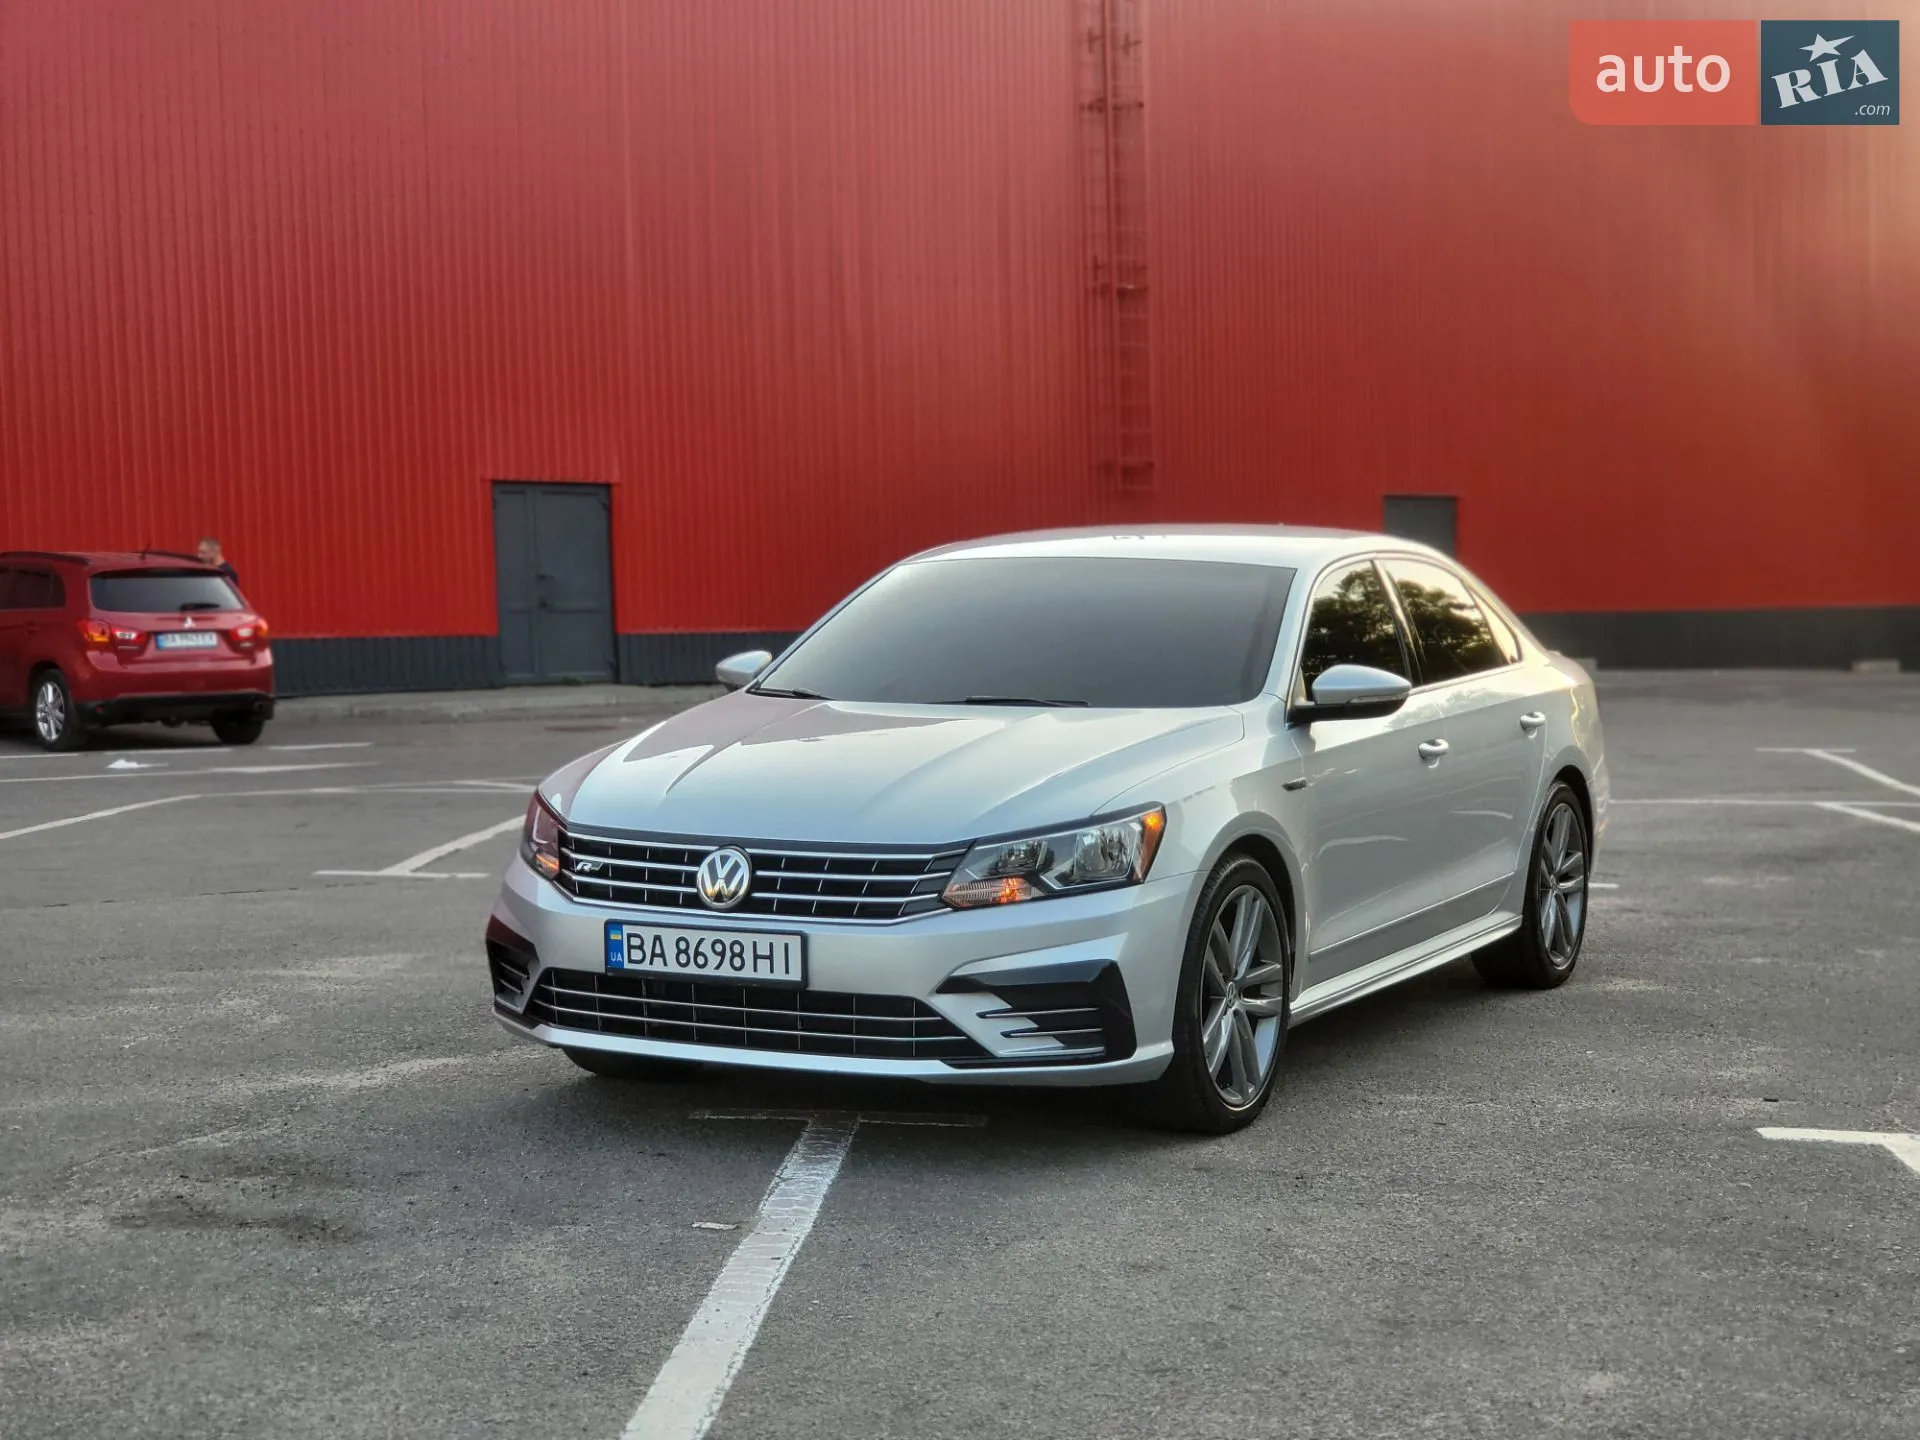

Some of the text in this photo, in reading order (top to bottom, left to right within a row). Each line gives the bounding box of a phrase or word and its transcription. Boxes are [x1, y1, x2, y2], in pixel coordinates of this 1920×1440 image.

[610, 951, 623, 963] UA
[626, 932, 790, 975] BA 8698 HI
